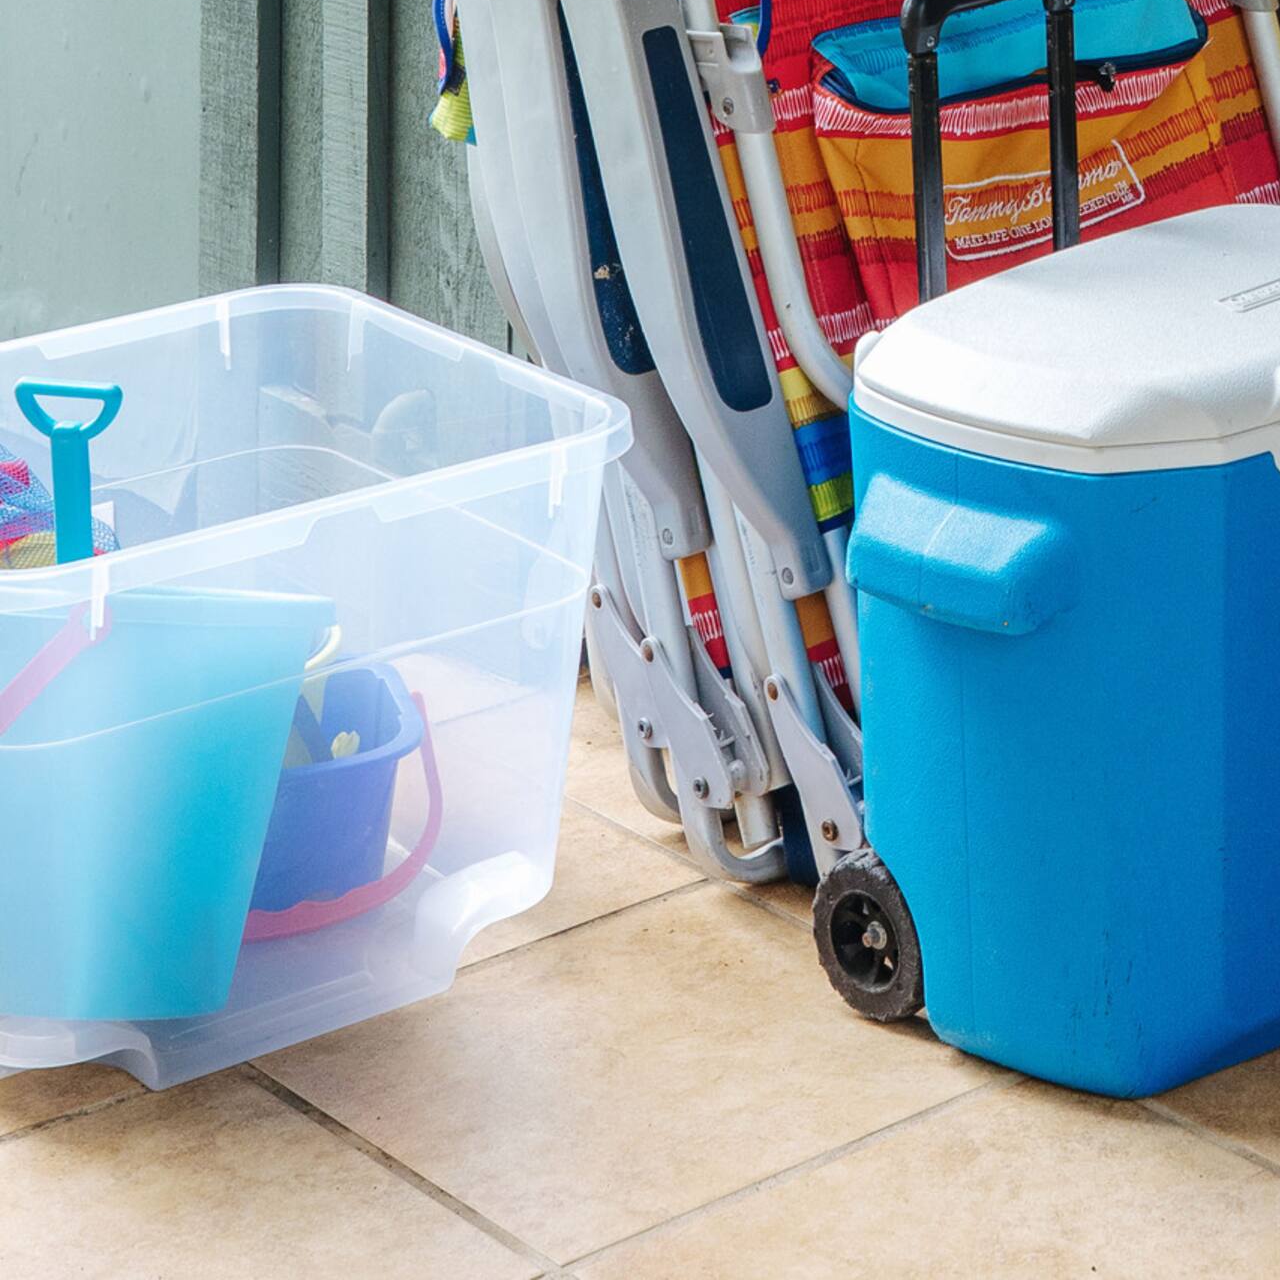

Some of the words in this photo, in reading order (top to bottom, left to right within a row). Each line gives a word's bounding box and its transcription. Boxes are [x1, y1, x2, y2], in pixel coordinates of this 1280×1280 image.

[944, 195, 1024, 226] Tommy
[954, 233, 986, 250] MAKE
[986, 228, 1009, 244] LIFE
[1009, 223, 1035, 239] ONE
[1035, 216, 1053, 232] LON
[1079, 190, 1120, 216] EEKEND
